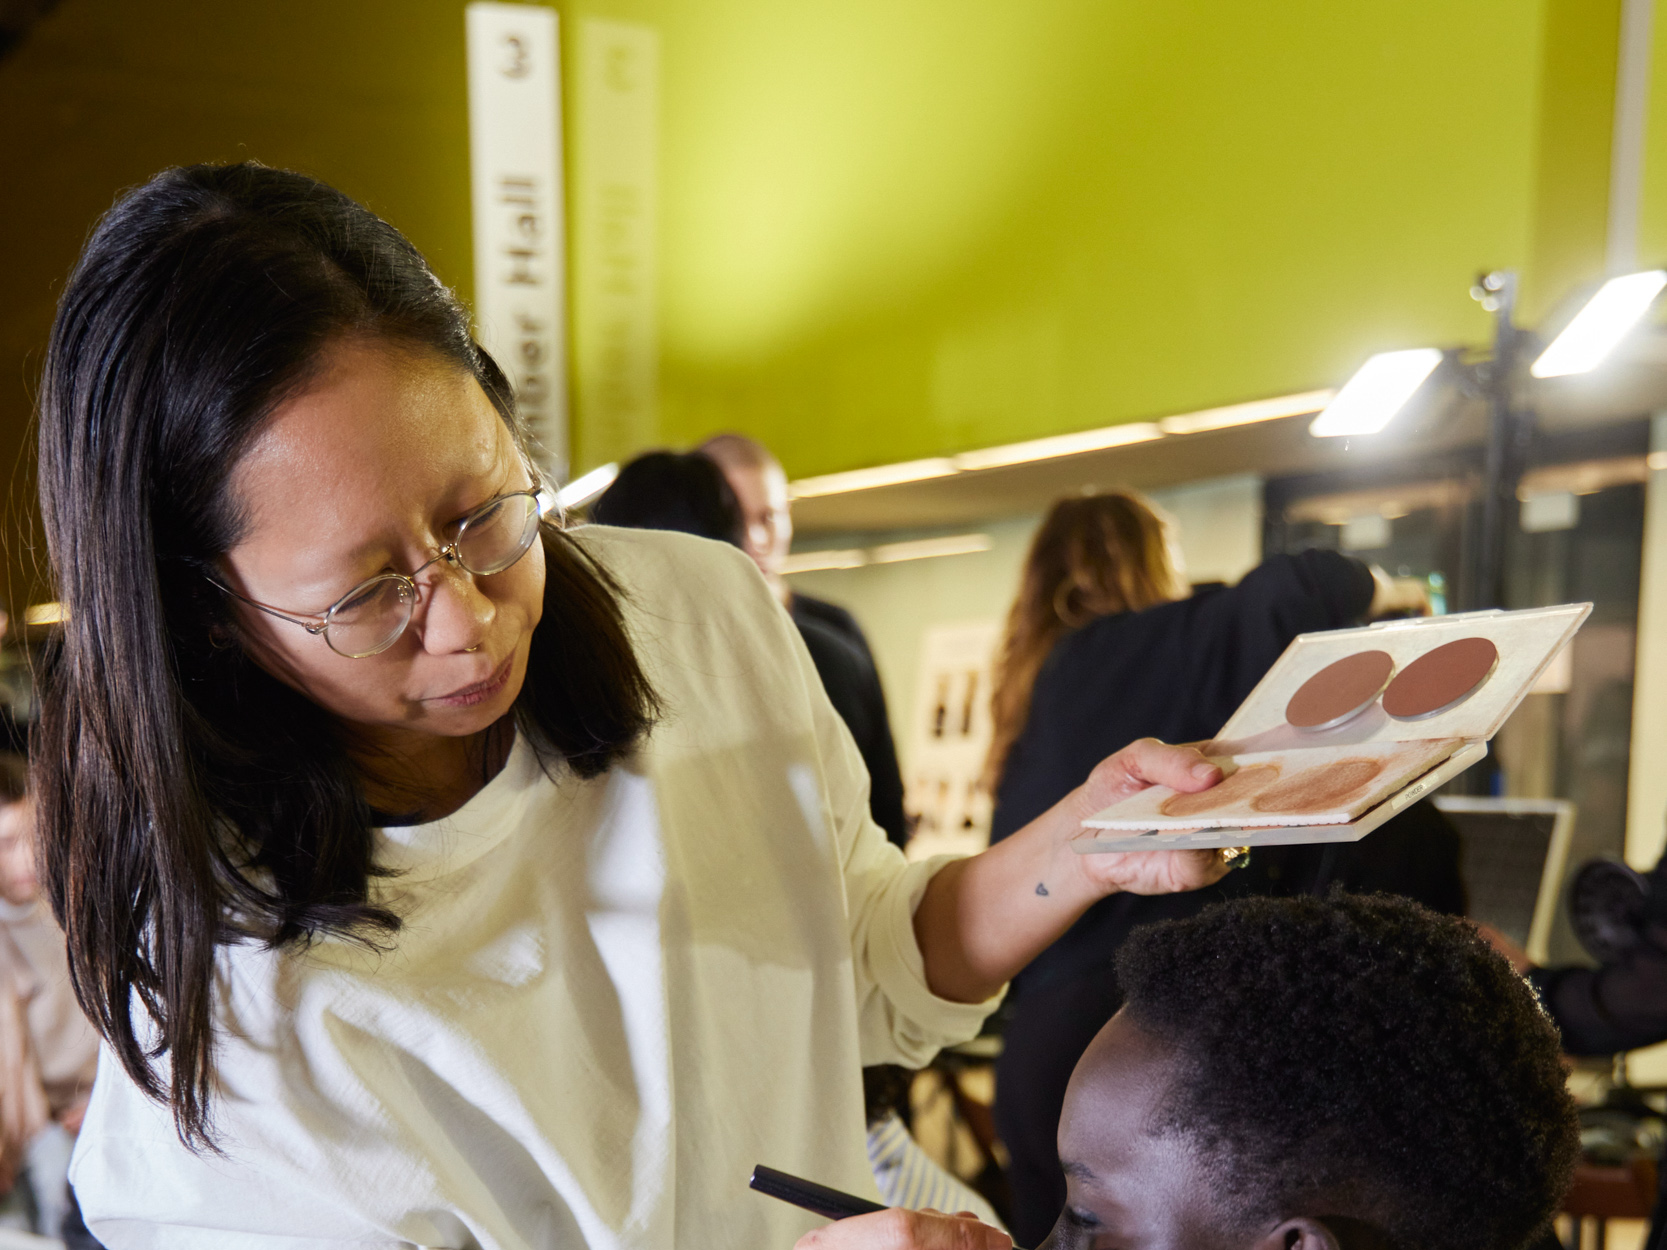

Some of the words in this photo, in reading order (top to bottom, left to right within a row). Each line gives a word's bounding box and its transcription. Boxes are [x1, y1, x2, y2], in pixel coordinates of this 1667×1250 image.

[500, 175, 541, 287] Hall
[514, 312, 550, 466] mber
[1405, 784, 1424, 801] POWDER
